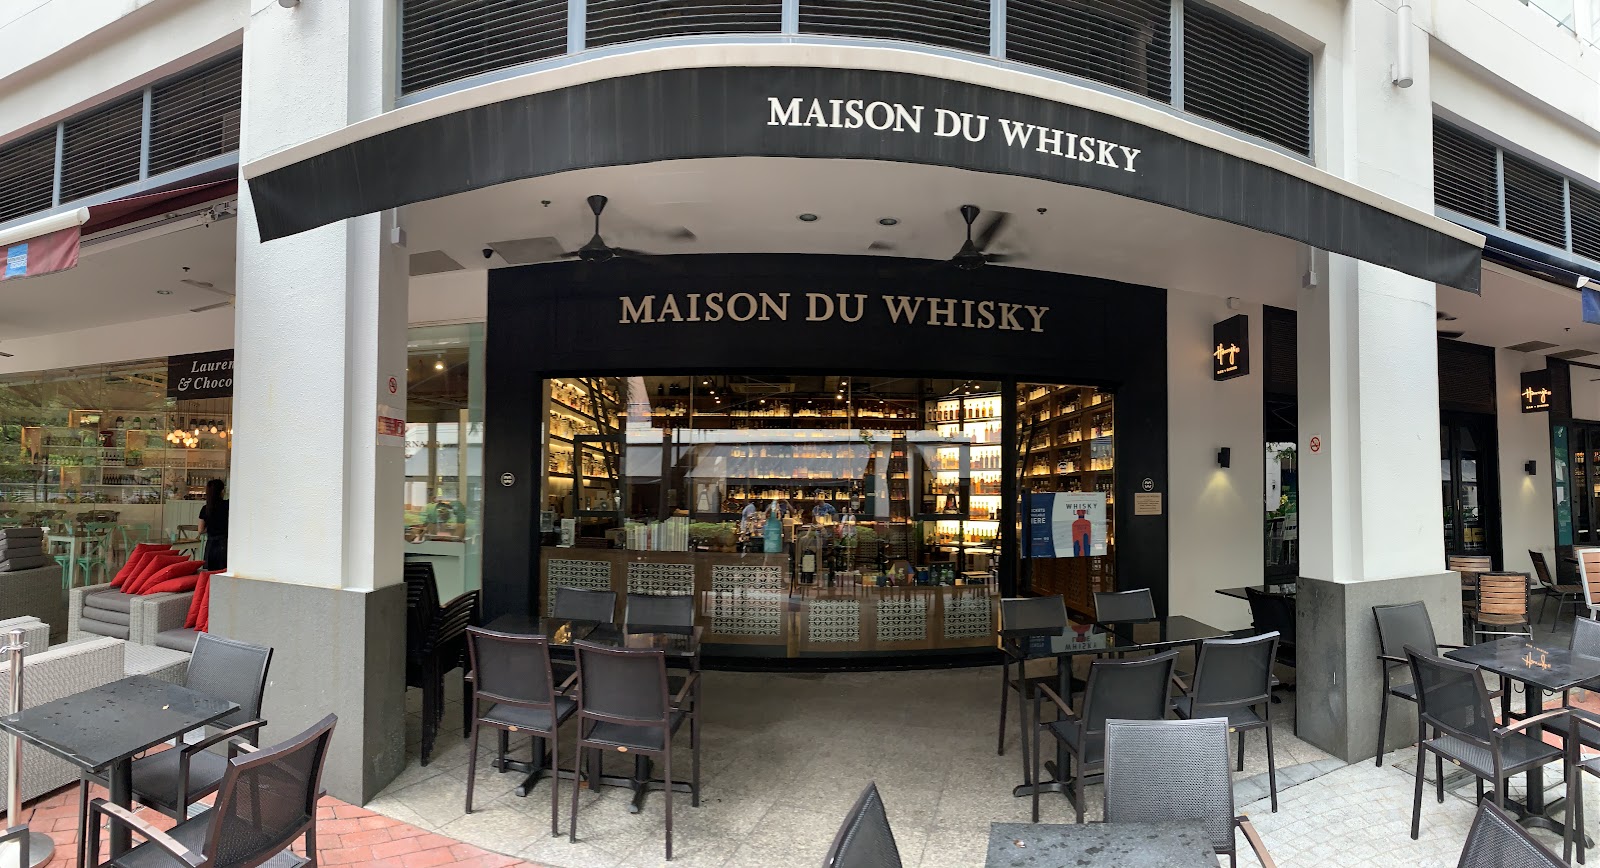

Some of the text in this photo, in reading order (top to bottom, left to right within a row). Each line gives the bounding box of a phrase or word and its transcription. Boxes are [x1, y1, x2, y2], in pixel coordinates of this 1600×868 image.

[767, 97, 1141, 173] MAISON DU WHISKY
[619, 292, 1050, 333] MAISON DU WHISKY
[178, 376, 233, 391] & Choco
